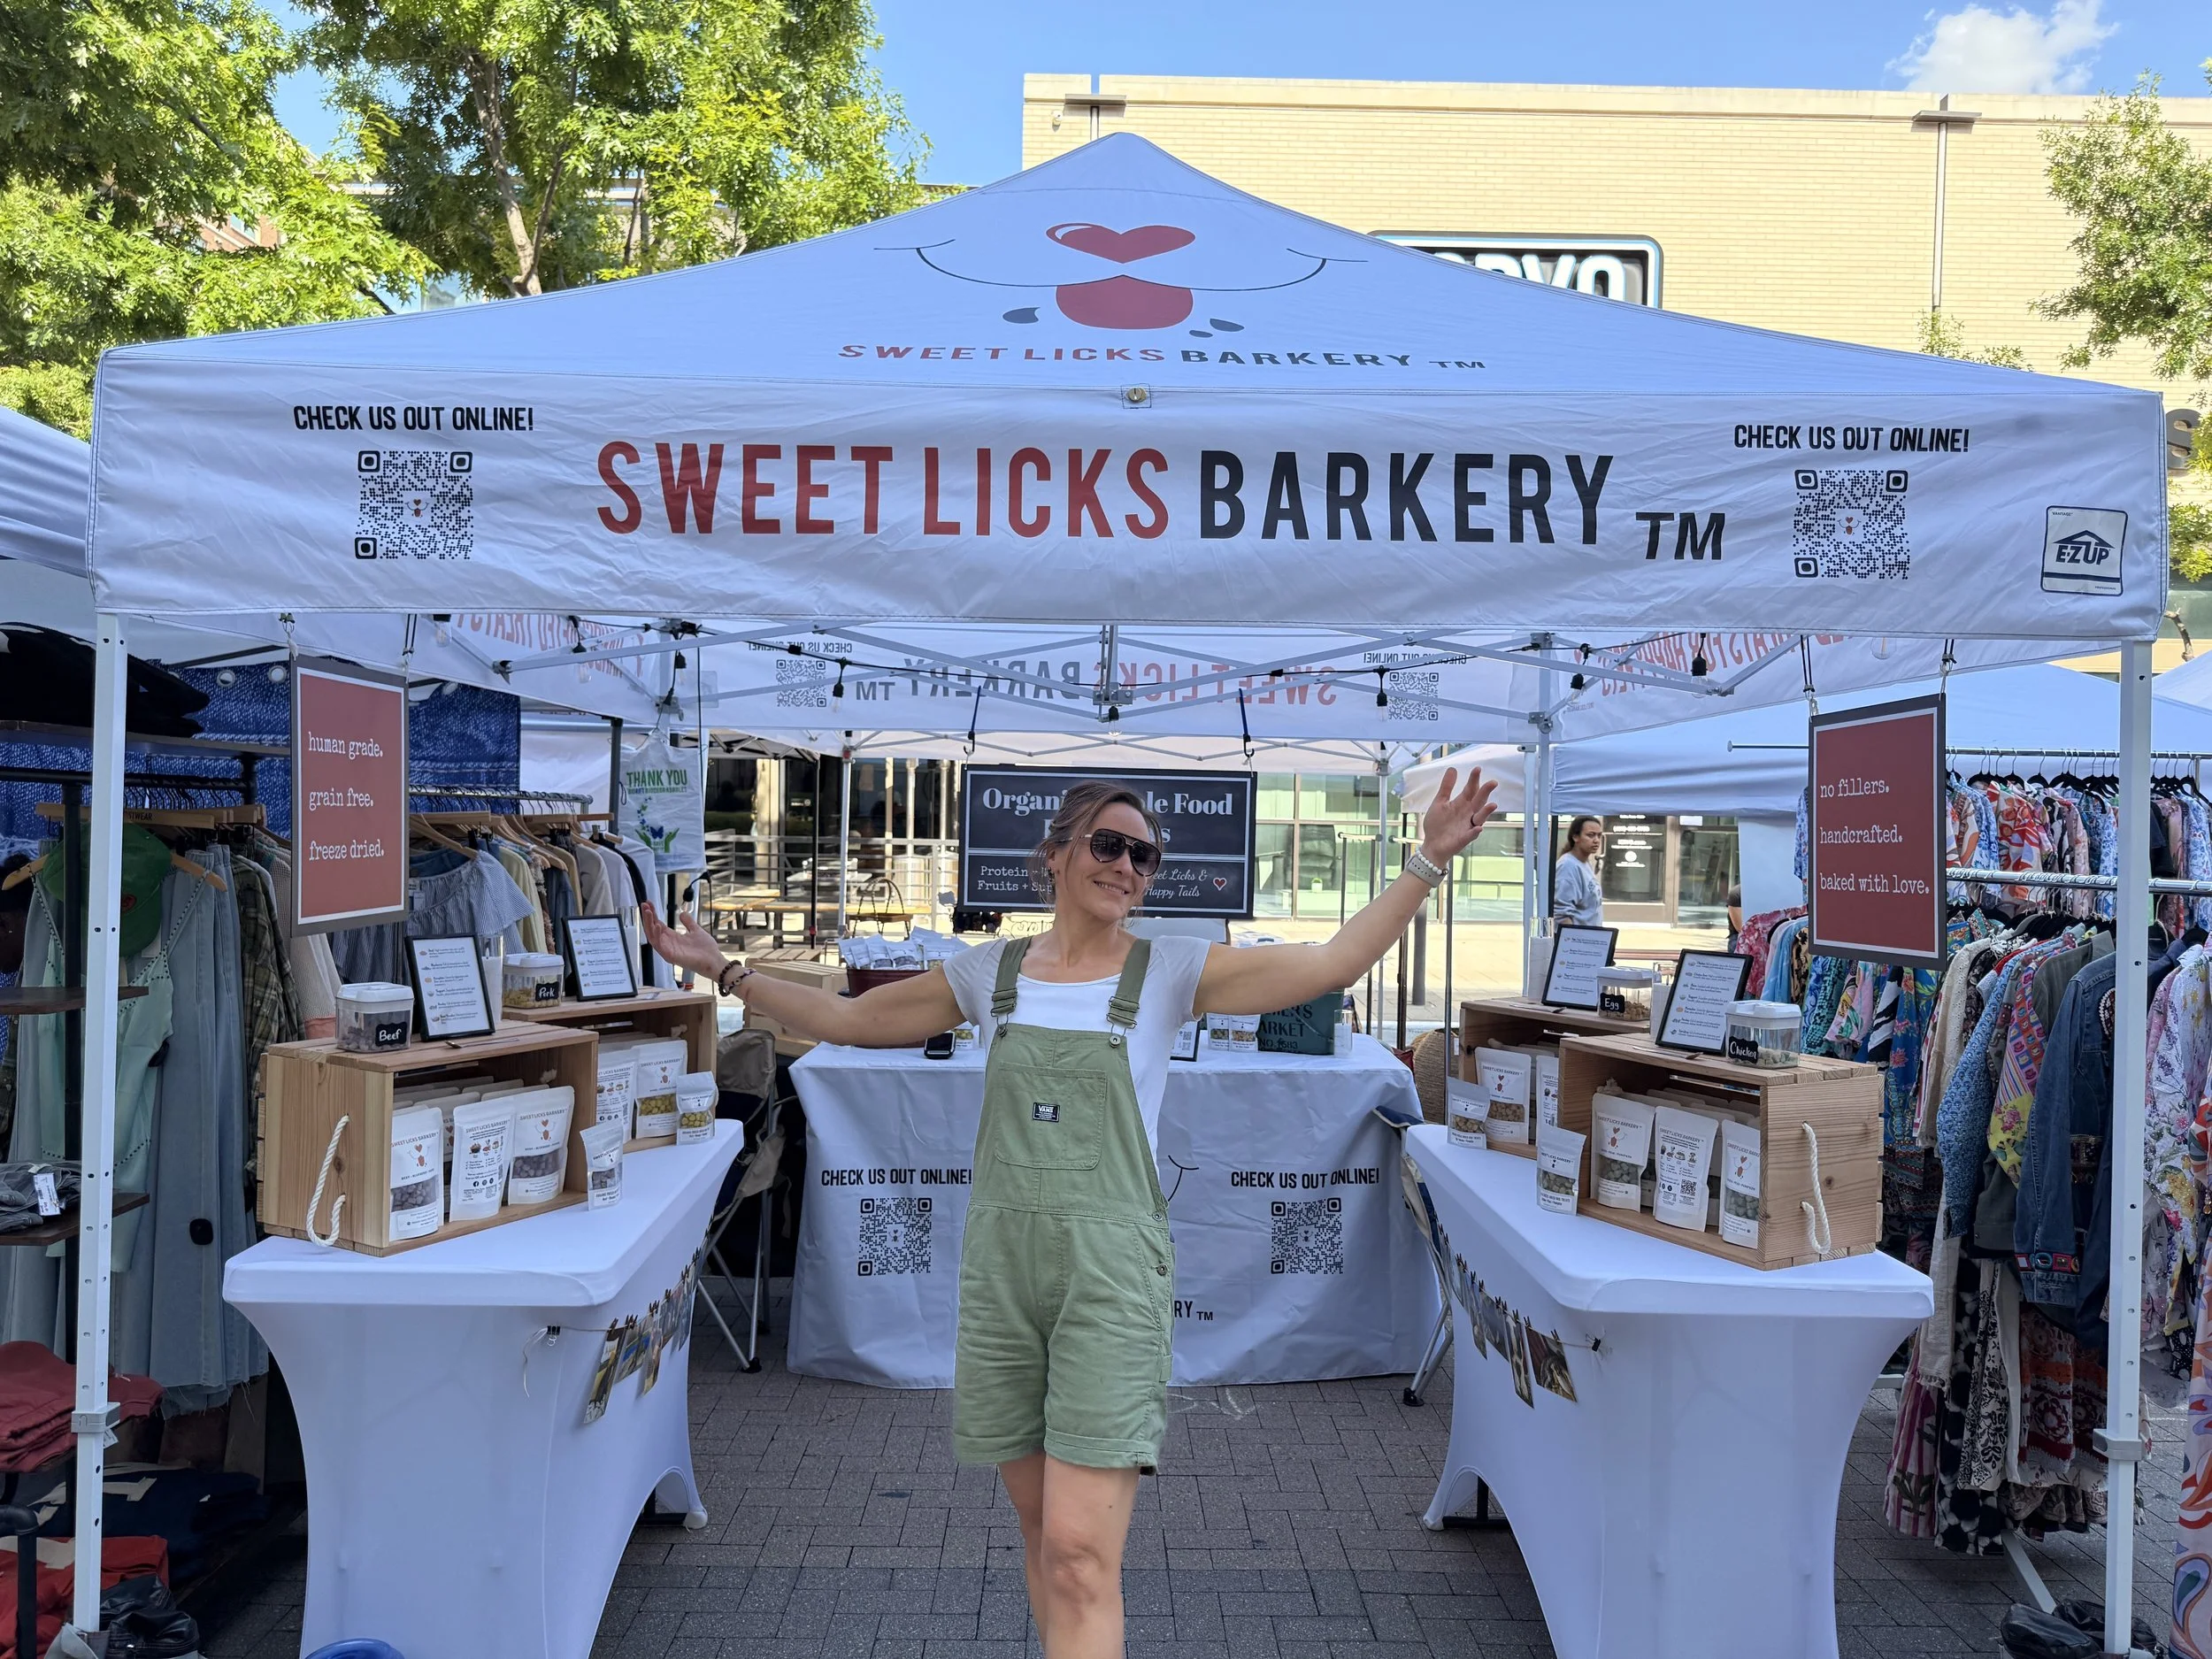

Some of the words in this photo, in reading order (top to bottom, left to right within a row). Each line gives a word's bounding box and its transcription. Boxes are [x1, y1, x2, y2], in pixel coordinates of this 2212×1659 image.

[839, 345, 1008, 361] SWEET
[1024, 348, 1165, 362] LICKS
[1181, 349, 1413, 368] BARKERY
[294, 406, 366, 430] CHECK
[369, 406, 397, 430] US
[403, 406, 445, 431] OUT
[452, 407, 534, 432] ONLINE!
[1734, 425, 1801, 449] CHECK
[1809, 426, 1836, 450] US
[1842, 427, 1885, 450] OUT
[1890, 428, 1970, 453] ONLINE!
[597, 441, 893, 535] SWEET
[923, 447, 1169, 539] LICKS
[1201, 449, 1614, 545] BARKERY
[1635, 511, 1725, 560] TM
[309, 732, 345, 754] human
[349, 739, 383, 759] grade.
[626, 770, 664, 787] THANK
[666, 769, 687, 786] YOU
[1820, 785, 1834, 797] no
[1838, 778, 1889, 796] fillers.
[310, 787, 343, 810] grain
[347, 787, 373, 807] free.
[1173, 793, 1233, 815] Food
[1820, 825, 1902, 843] handcrafted.
[310, 841, 347, 861] freeze
[350, 839, 384, 859] dried.
[980, 865, 1028, 877] Protein
[1169, 869, 1195, 880] Licks
[1198, 870, 1208, 881] &
[978, 879, 1019, 891] Fruits
[1179, 885, 1201, 897] Tails
[1820, 873, 1855, 891] baked
[1859, 874, 1889, 893] with
[1893, 875, 1930, 895] love.
[1604, 997, 1620, 1011] Egg
[379, 1029, 402, 1042] Beef
[1730, 1041, 1758, 1060] Chicken
[821, 1169, 864, 1187] CHECK
[868, 1168, 886, 1187] US
[889, 1168, 917, 1187] OUT
[920, 1167, 972, 1185] ONLINE!
[1231, 1171, 1276, 1189] CHECK
[1279, 1171, 1297, 1189] US
[1301, 1171, 1327, 1190] OUT
[1330, 1167, 1379, 1187] ONLINE!
